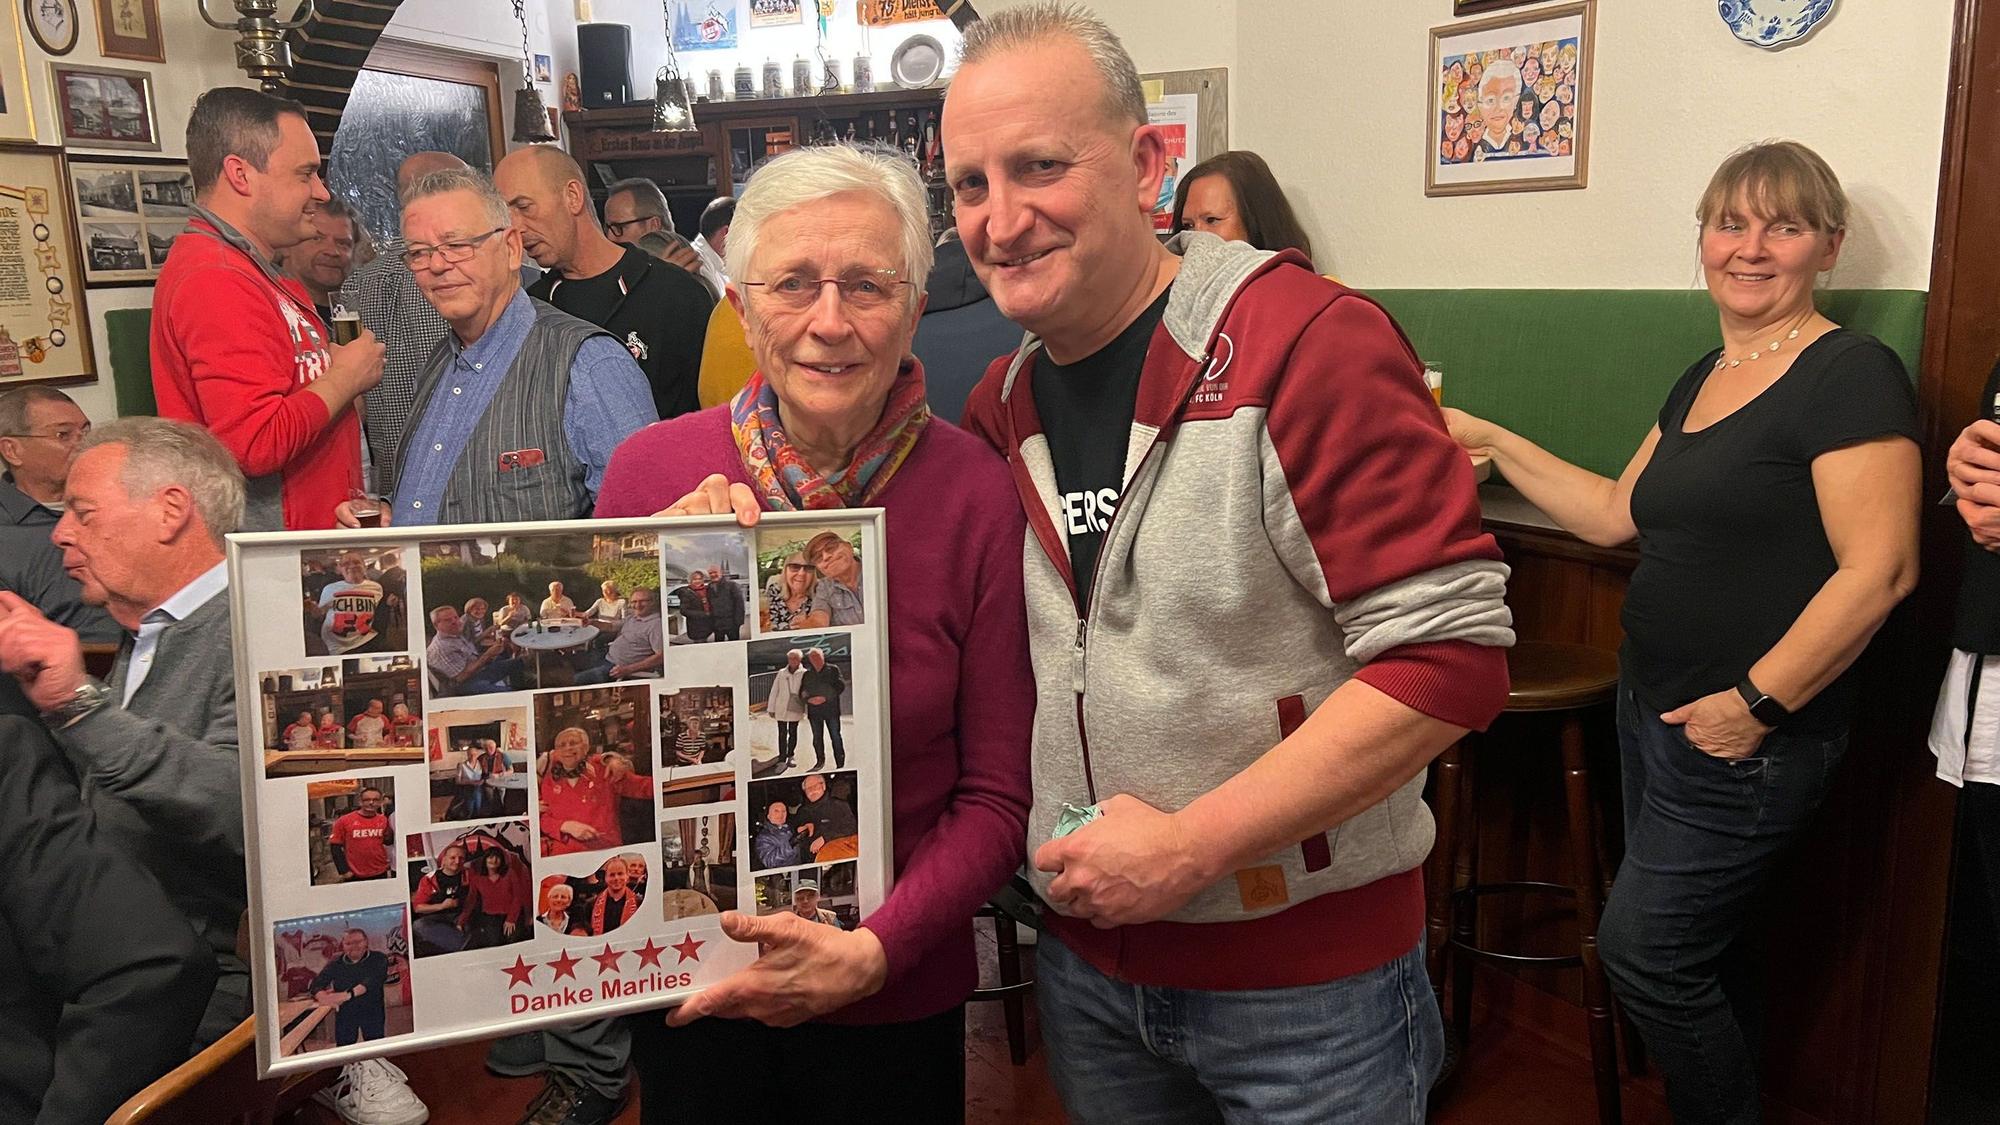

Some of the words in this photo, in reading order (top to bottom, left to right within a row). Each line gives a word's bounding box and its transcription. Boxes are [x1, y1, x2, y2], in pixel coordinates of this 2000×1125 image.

[1195, 394, 1204, 403] FC
[1205, 392, 1223, 402] KÖLN
[332, 598, 354, 612] ICH
[511, 986, 593, 1014] Danke
[601, 971, 692, 1000] Marlies
